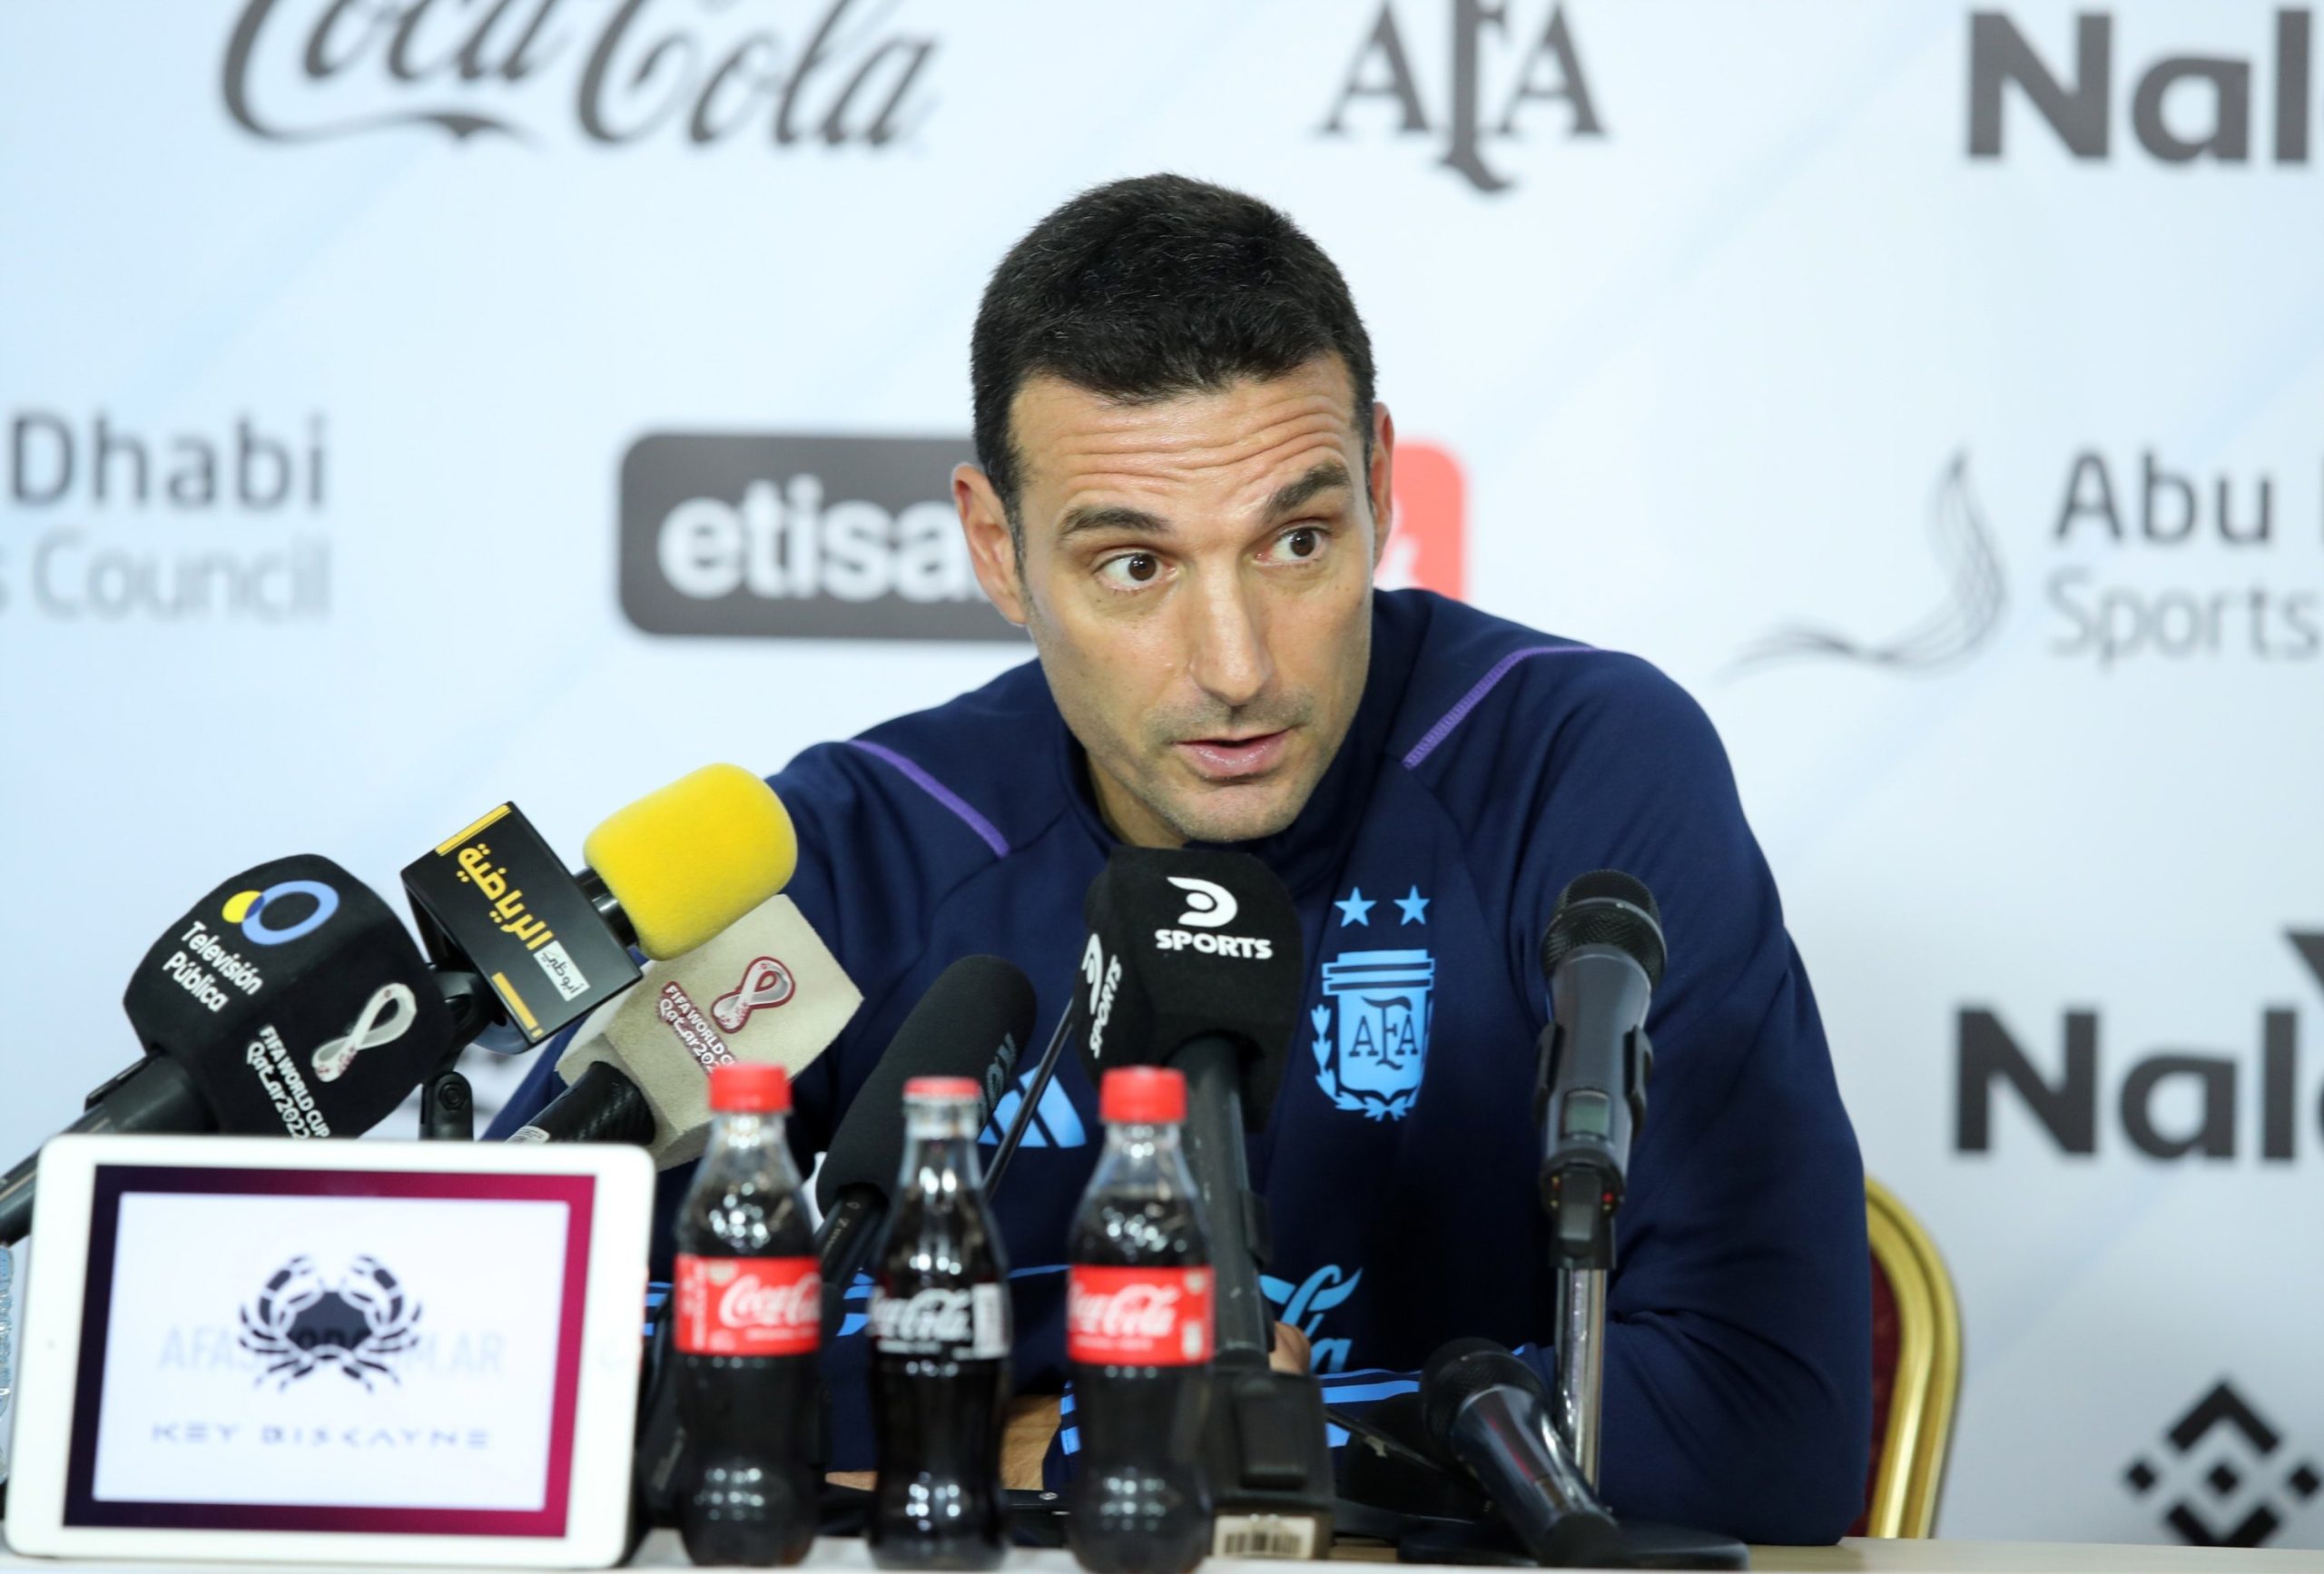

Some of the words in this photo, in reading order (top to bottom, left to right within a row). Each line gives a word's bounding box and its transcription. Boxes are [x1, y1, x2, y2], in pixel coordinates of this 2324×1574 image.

[9, 408, 327, 512] Dhabi
[2054, 447, 2273, 548] Abu
[657, 472, 992, 603] etisa
[2045, 566, 2322, 674] Sports
[162, 950, 229, 1012] Pública
[181, 920, 263, 995] Televisión
[1154, 929, 1274, 959] SPORTS
[665, 985, 691, 1014] FIFA
[686, 1009, 724, 1054] WORLD
[1089, 955, 1122, 1059] SPORTS
[1348, 995, 1419, 1071] AFA
[260, 1025, 287, 1061] FIFA
[277, 1057, 315, 1112] WORLD
[305, 1109, 330, 1138] CUP
[1954, 1005, 2324, 1163] Nal
[151, 1420, 241, 1446] KEY
